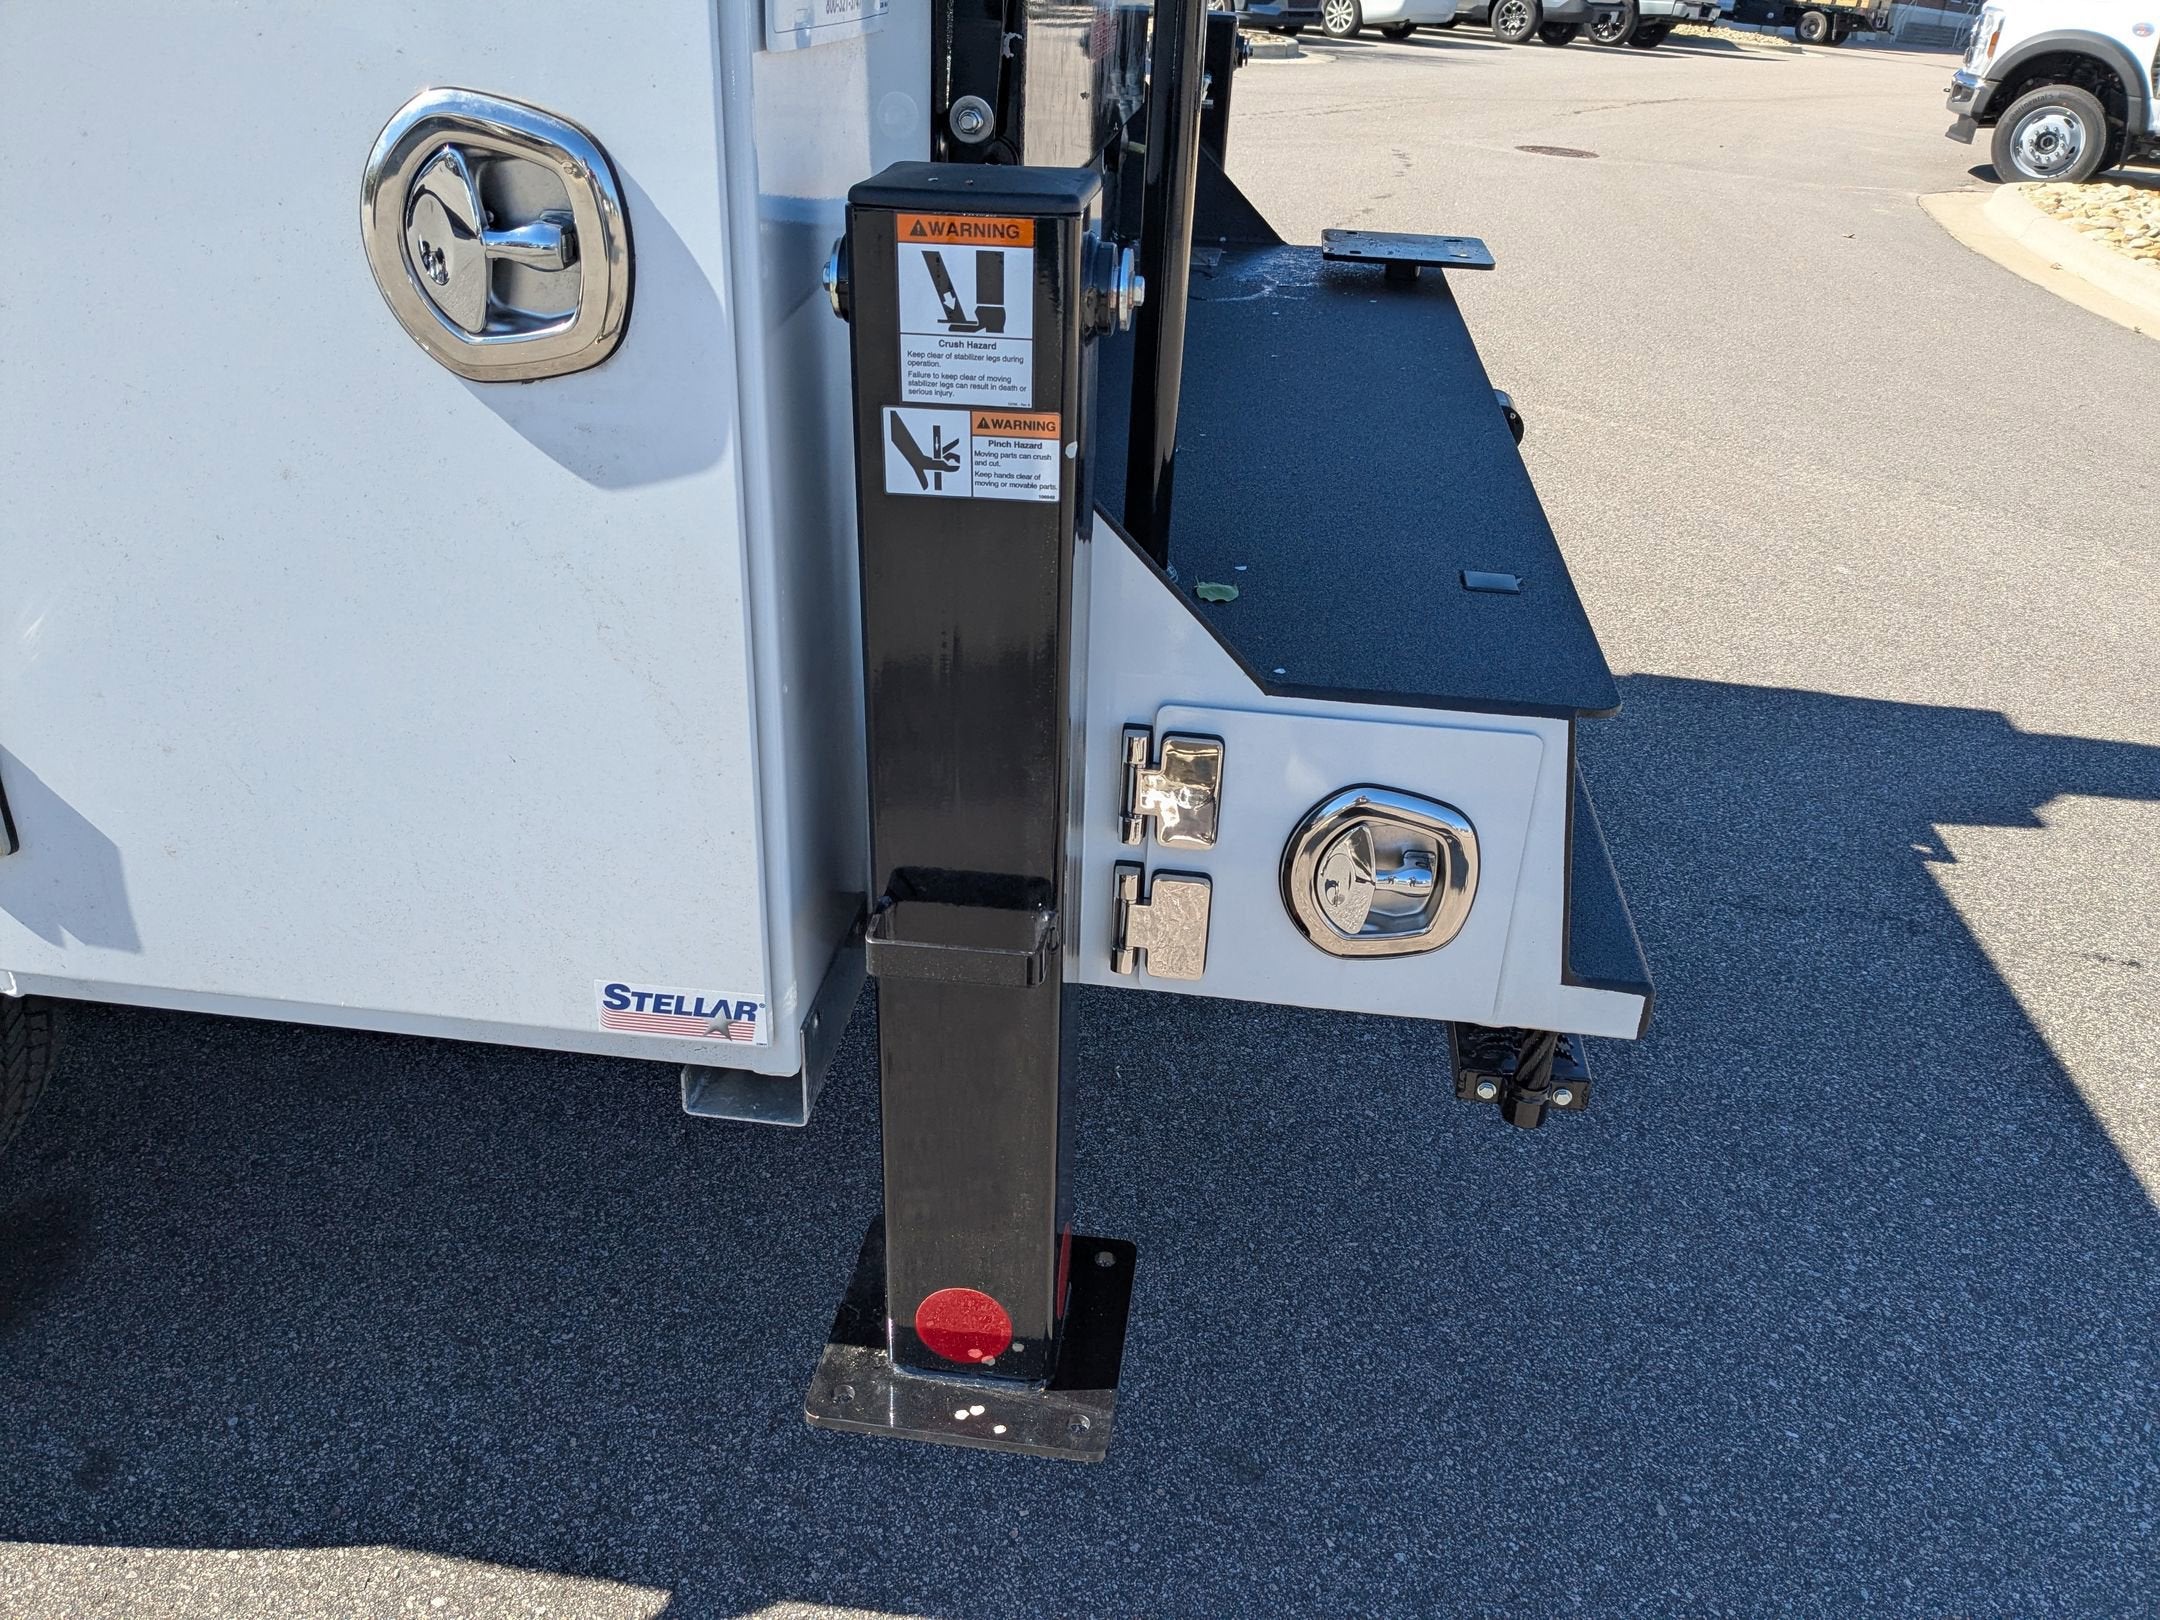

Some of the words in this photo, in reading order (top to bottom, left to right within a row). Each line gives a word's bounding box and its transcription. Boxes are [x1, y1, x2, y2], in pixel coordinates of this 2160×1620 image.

[928, 221, 1020, 239] WARNING
[938, 340, 964, 349] Crush
[967, 341, 997, 350] Hazard
[907, 351, 926, 360] Keep
[927, 351, 944, 359] clear
[954, 352, 984, 361] stabilizer
[986, 354, 1000, 362] legs
[1002, 355, 1024, 364] during
[908, 370, 931, 378] Failure
[941, 372, 958, 381] keep
[986, 375, 1012, 384] moving
[908, 380, 938, 388] stabilizer
[940, 381, 954, 389] legs
[970, 382, 989, 390] result
[934, 388, 954, 398] injury.
[990, 418, 1056, 432] WARNING
[988, 440, 1012, 448] Pinch
[1014, 441, 1042, 450] Hazard
[974, 450, 999, 459] Moving
[974, 471, 992, 479] Keep
[974, 480, 999, 488] moving
